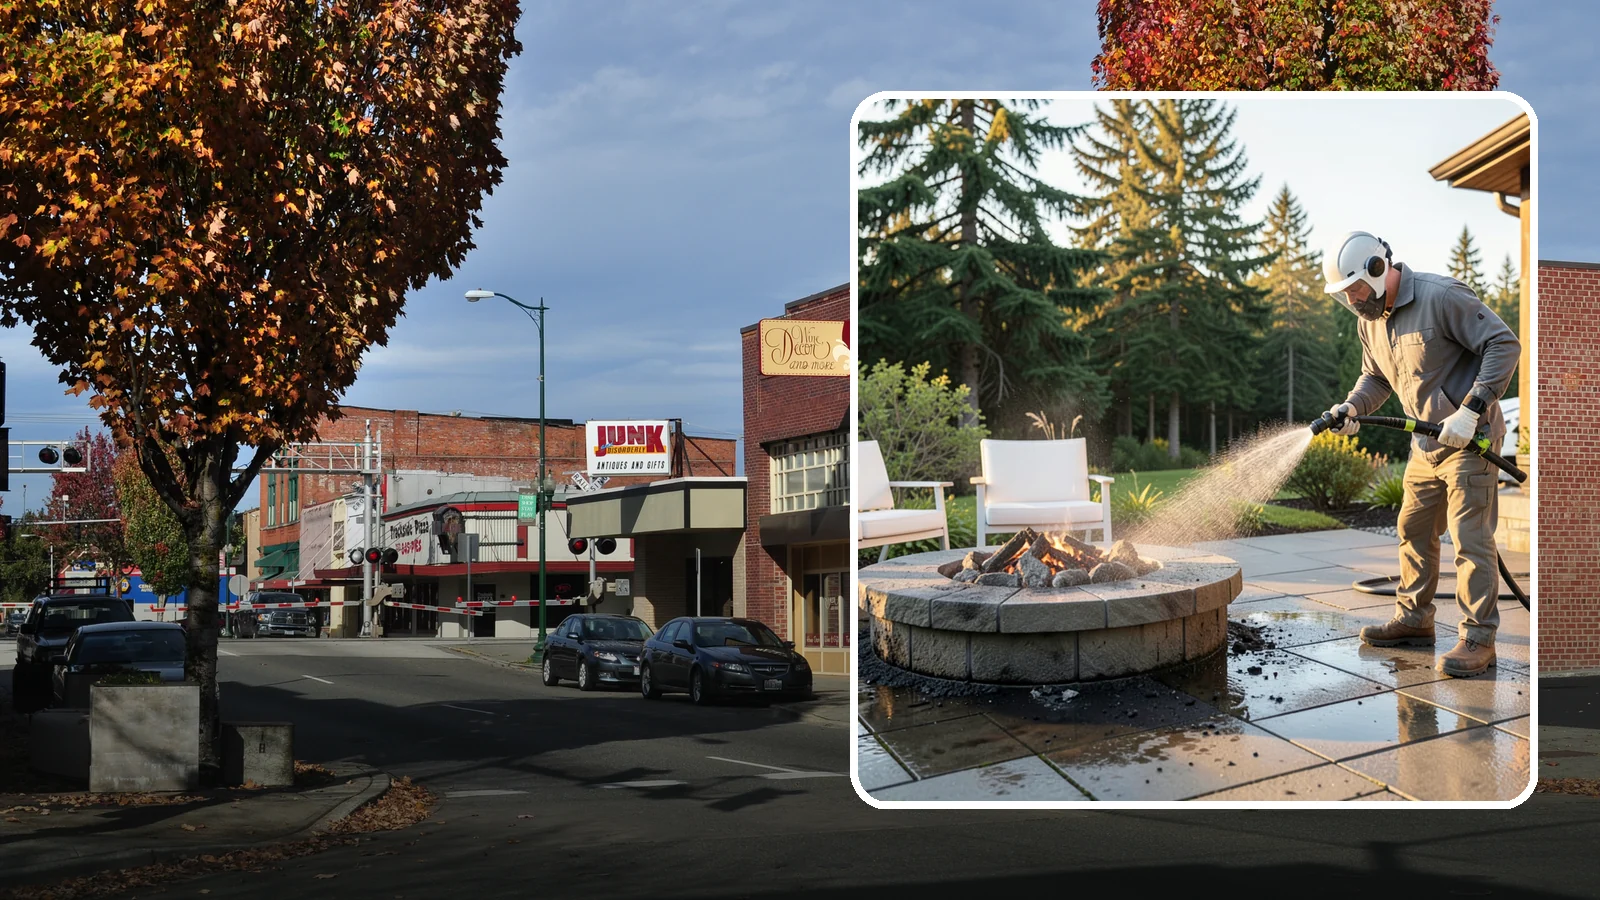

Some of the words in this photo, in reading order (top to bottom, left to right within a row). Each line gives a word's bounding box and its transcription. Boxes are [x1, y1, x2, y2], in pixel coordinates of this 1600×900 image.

[596, 425, 664, 457] JUNK
[597, 461, 628, 470] ANTIQUES
[631, 461, 644, 470] AND
[647, 460, 665, 469] GIFTS
[573, 473, 588, 491] RAIL
[590, 476, 609, 491] SING
[390, 521, 413, 539] Trackside
[414, 519, 429, 534] Pizza
